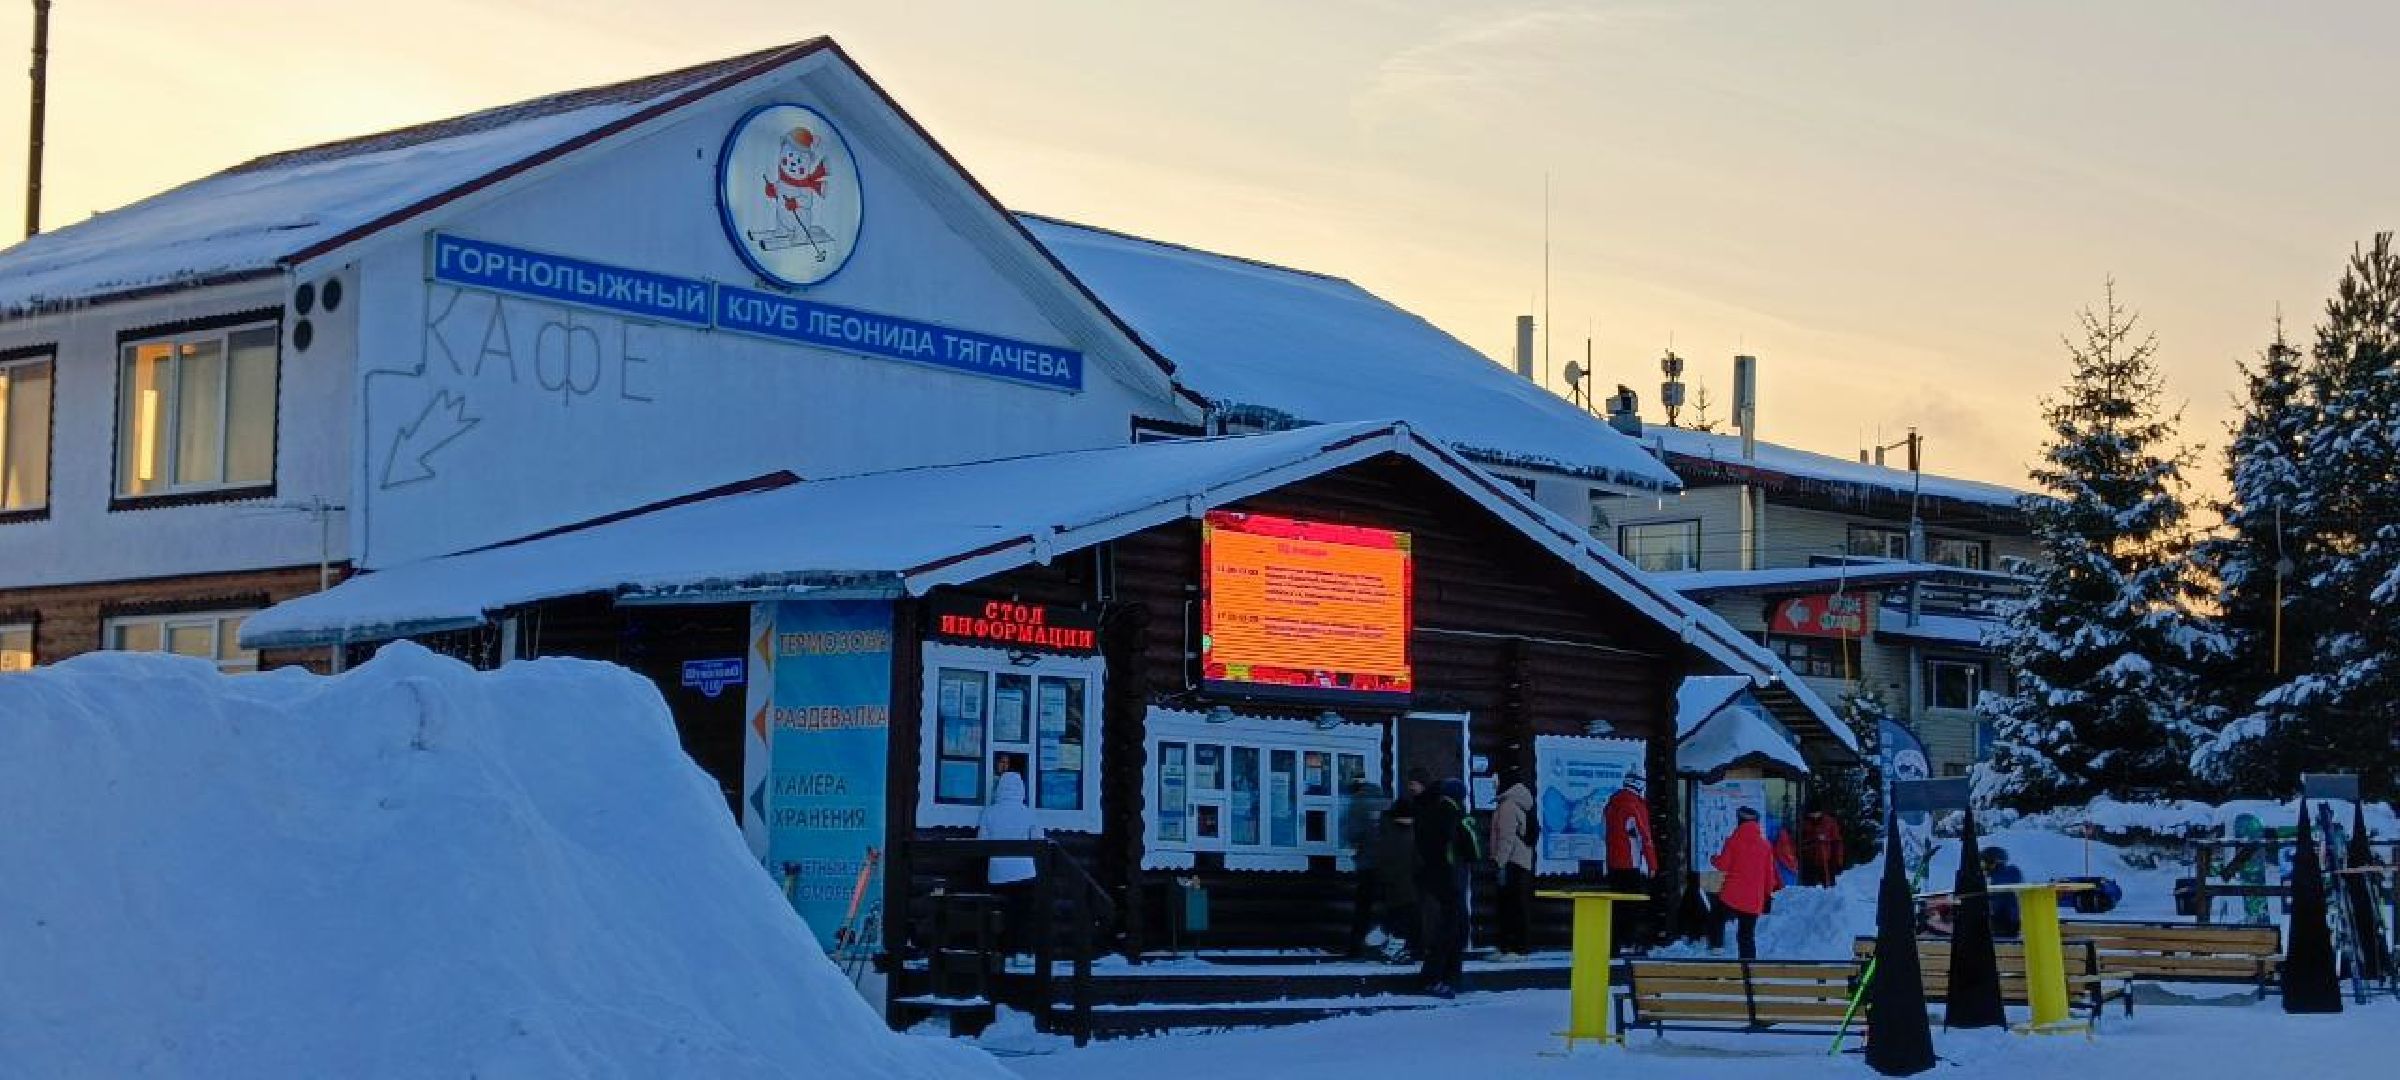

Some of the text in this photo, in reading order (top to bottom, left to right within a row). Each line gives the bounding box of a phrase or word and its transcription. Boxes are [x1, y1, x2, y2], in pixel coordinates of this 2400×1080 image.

[441, 245, 1072, 379] ГОРНОЛЫЖНЫЙ КЛУБ ЛЕОНИДА ТЯГАЧЕВА
[424, 286, 655, 405] КАФЕ
[985, 602, 1045, 625] СТОЛ
[941, 615, 1095, 648] ИНФОРМАЦИИ
[775, 706, 889, 730] РАЗДЕВАЛКА
[775, 775, 847, 796] КАМЕРА
[775, 808, 866, 828] ХРАНЕНИЯ
